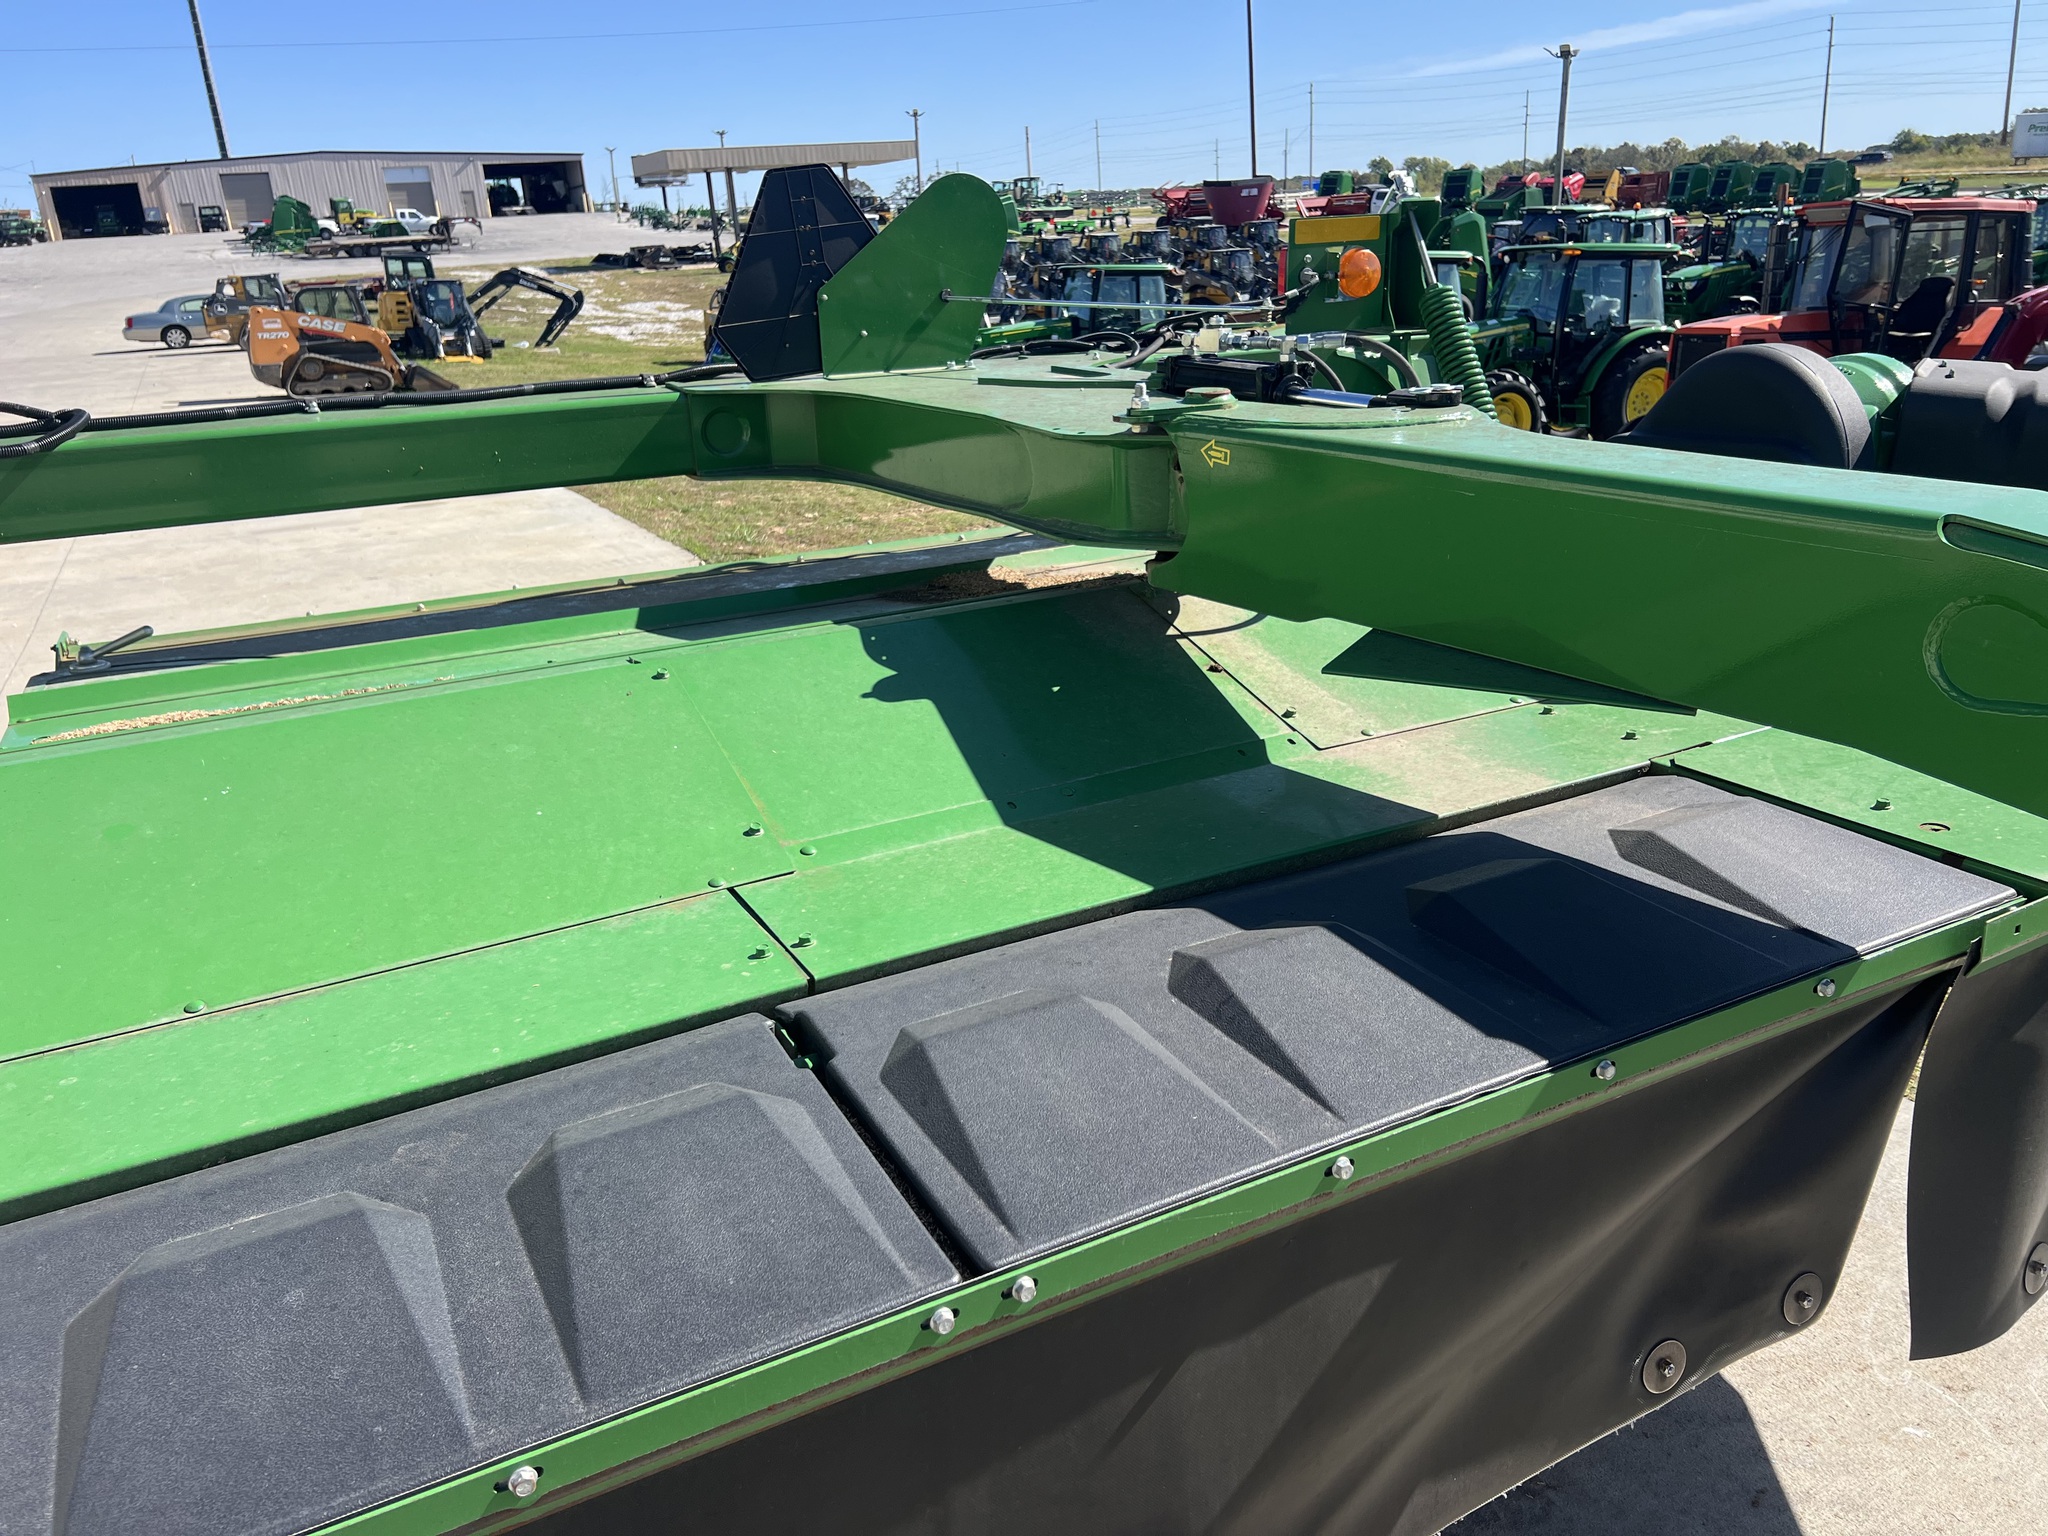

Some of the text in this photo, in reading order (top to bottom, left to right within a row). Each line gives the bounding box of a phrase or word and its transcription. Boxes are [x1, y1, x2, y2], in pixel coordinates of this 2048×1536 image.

[2027, 123, 2048, 133] Pre
[297, 315, 347, 333] CASE
[257, 331, 290, 340] TR270
